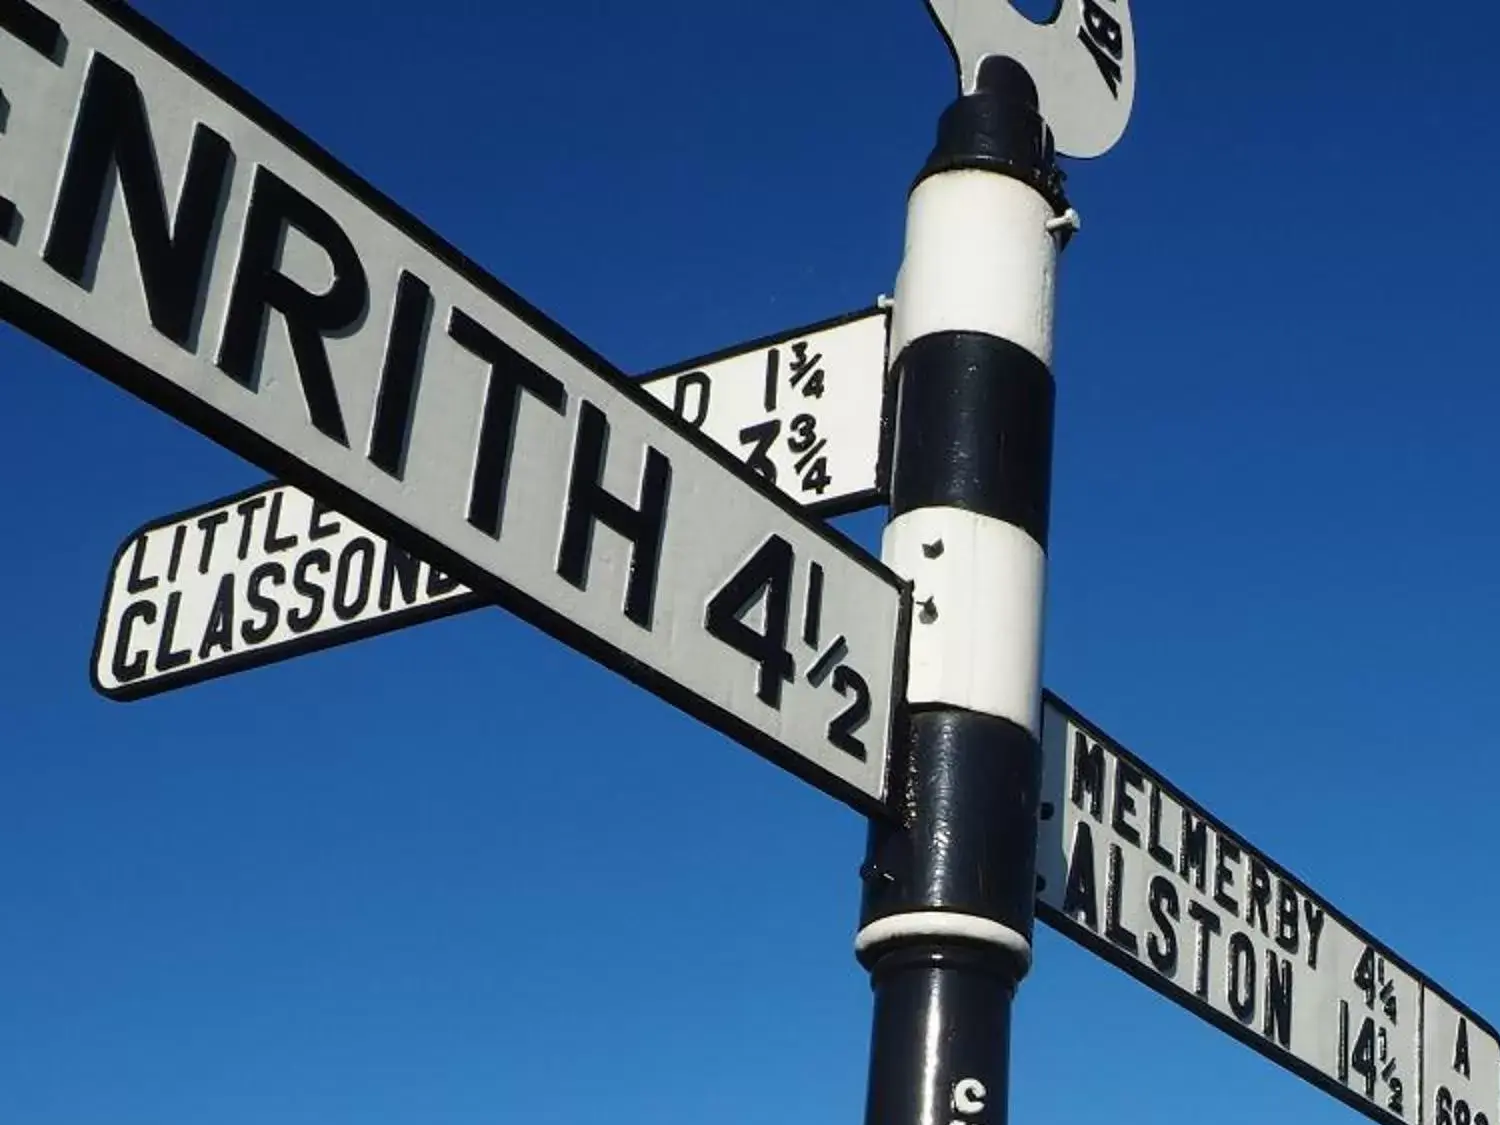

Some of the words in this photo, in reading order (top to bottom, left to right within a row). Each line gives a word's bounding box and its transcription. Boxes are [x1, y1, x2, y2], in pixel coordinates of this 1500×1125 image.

[1063, 821, 1294, 1051] ALSTON
[1071, 731, 1325, 970] MELMERBY
[1453, 1016, 1471, 1081] A
